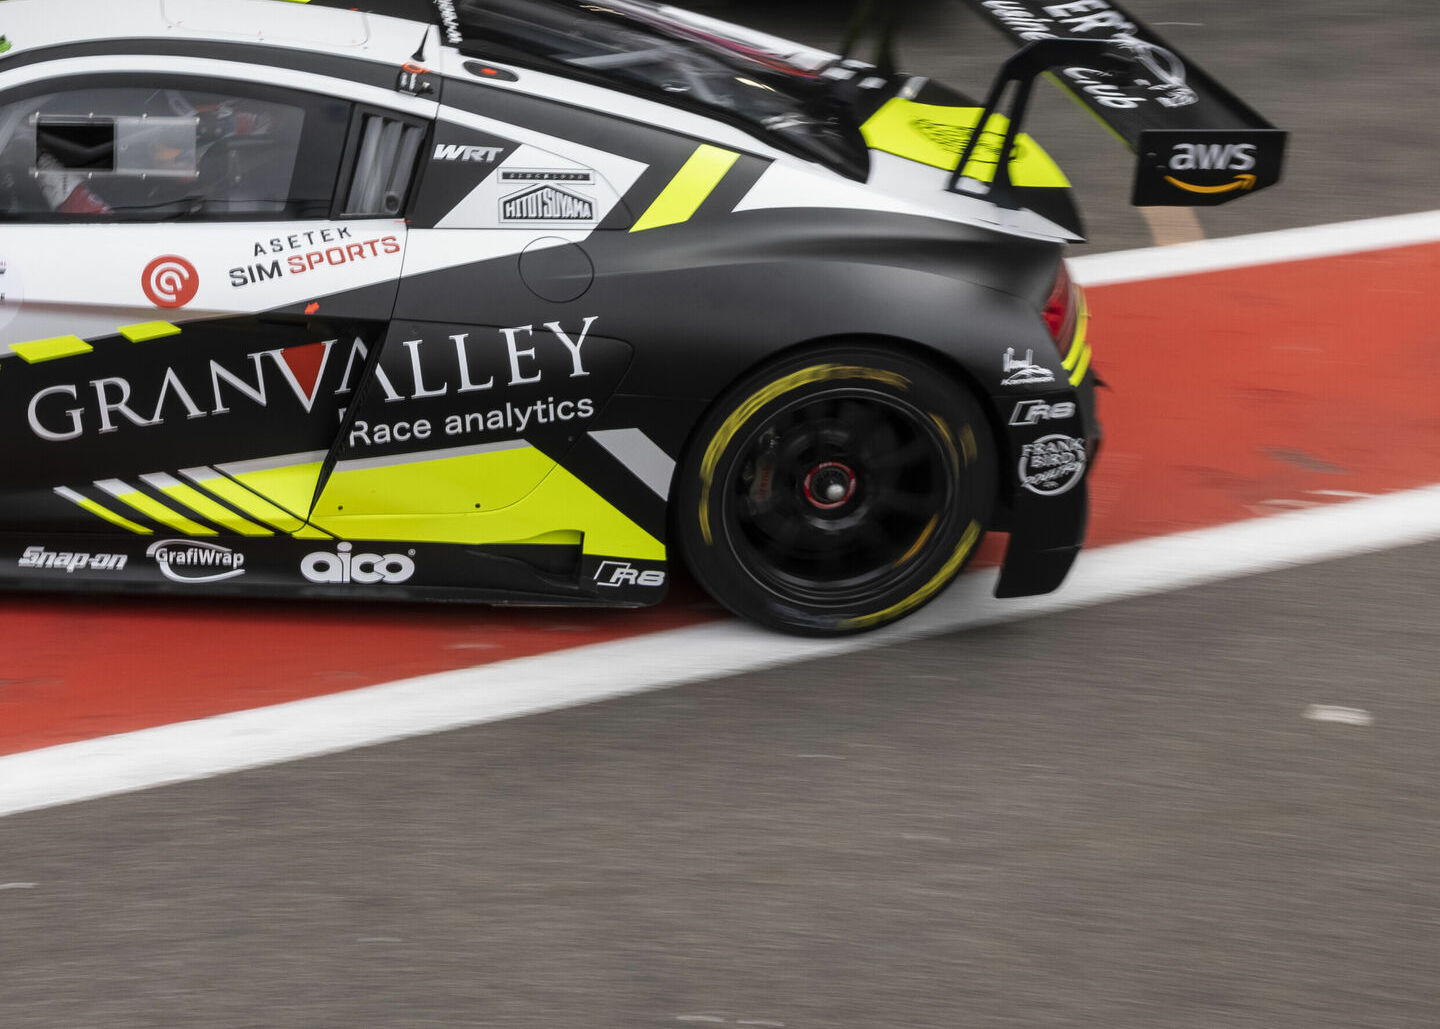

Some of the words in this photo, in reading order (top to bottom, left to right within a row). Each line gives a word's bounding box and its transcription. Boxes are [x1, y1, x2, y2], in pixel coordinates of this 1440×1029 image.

[433, 143, 505, 164] WRT
[1168, 142, 1258, 171] aws
[253, 226, 352, 257] ASETEK
[228, 259, 283, 287] SIM
[286, 235, 401, 274] SPORTS
[26, 315, 600, 442] GRANVALLEY
[340, 412, 432, 448] Race
[444, 395, 596, 435] analytics
[1013, 399, 1077, 425] R8
[18, 545, 129, 573] Snap-on
[156, 547, 245, 569] GrafiWrap
[300, 541, 415, 584] aico
[602, 562, 667, 587] R8
